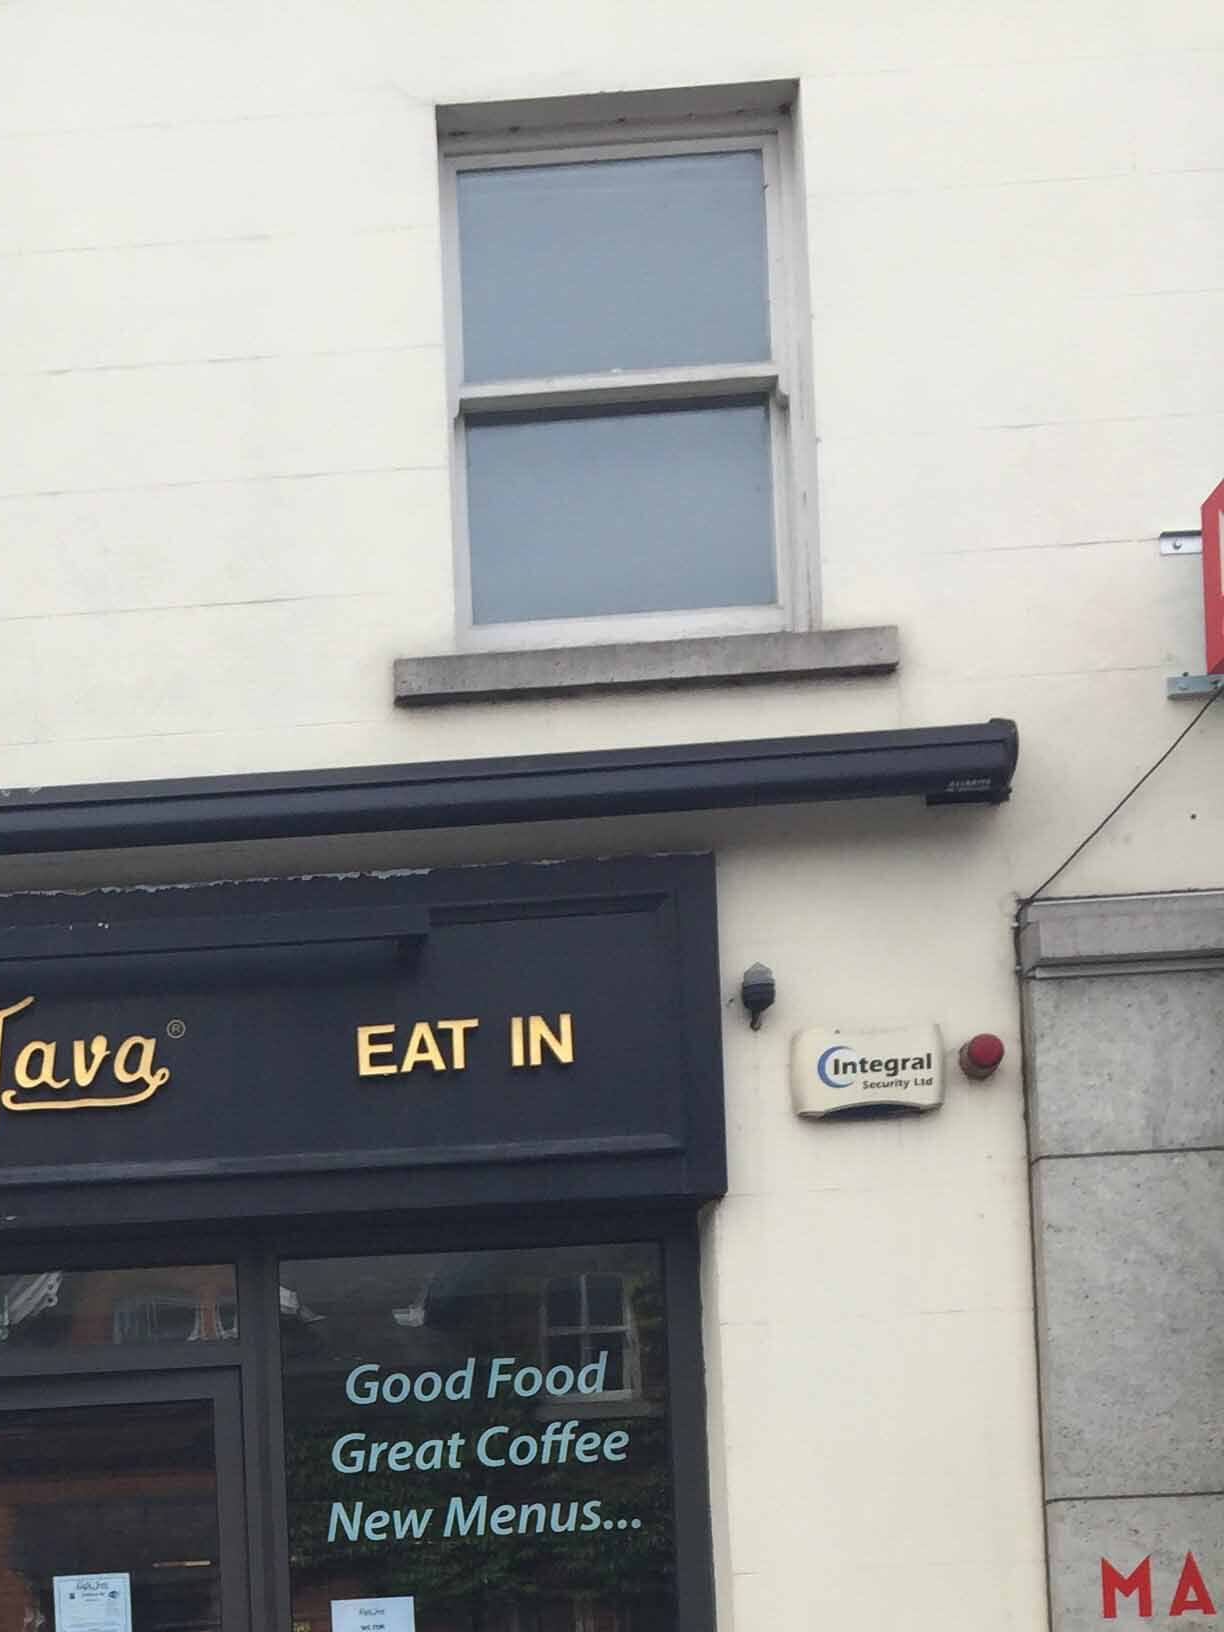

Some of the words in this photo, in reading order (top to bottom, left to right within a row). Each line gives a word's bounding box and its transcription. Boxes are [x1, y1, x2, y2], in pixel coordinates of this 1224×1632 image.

[357, 1017, 480, 1077] EAT
[510, 1012, 575, 1068] IN
[832, 1052, 933, 1078] Integral
[862, 1078, 911, 1091] Security
[913, 1076, 934, 1087] Ltd
[344, 1357, 476, 1406] Good
[486, 1350, 610, 1399] Food
[330, 1431, 466, 1475] Great
[475, 1420, 630, 1469] Coffee
[326, 1500, 433, 1543] New
[1099, 1550, 1224, 1619] MA
